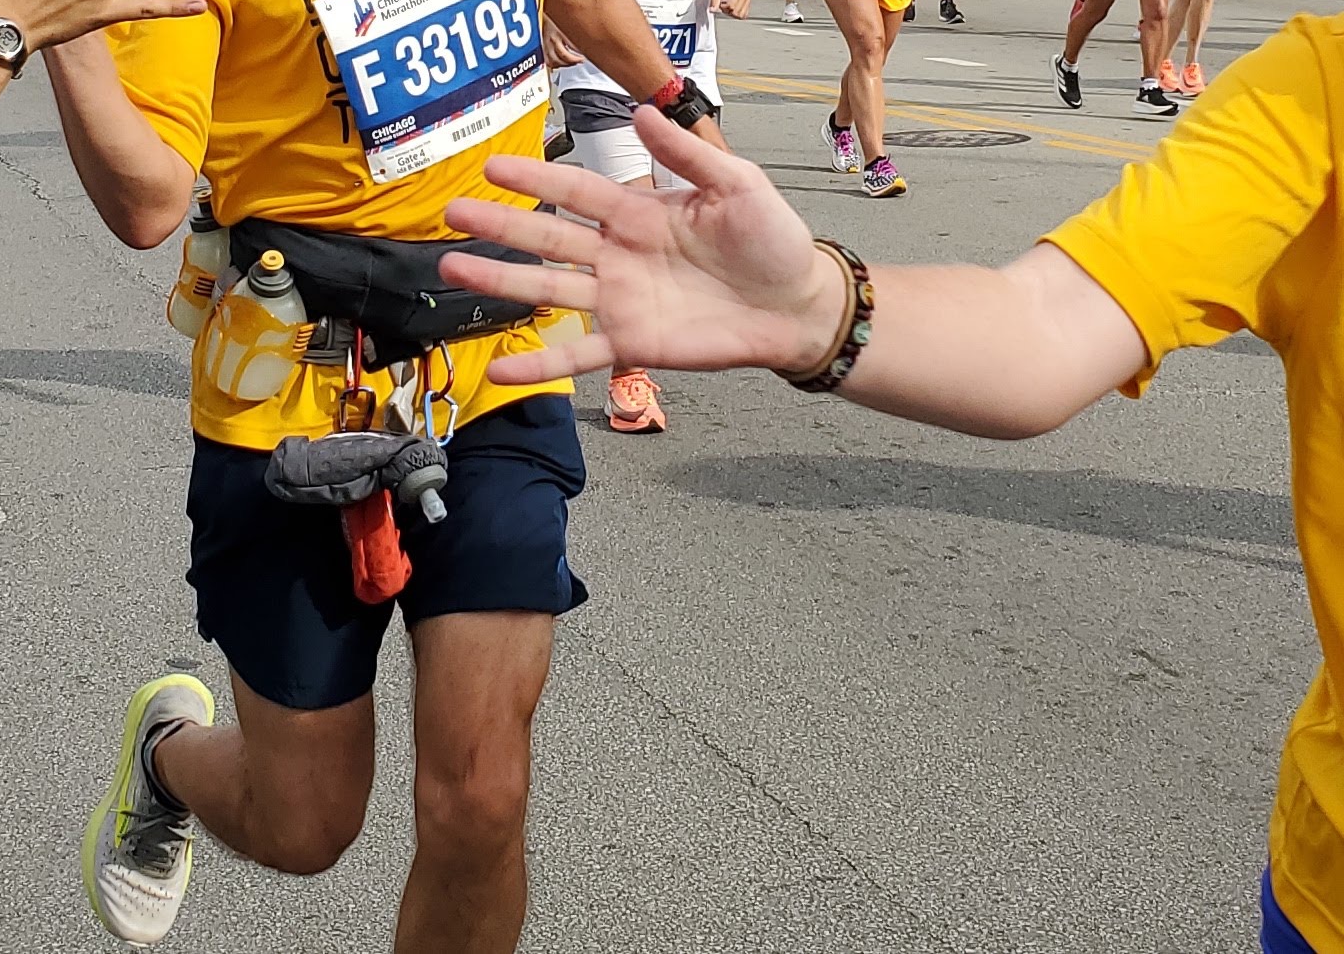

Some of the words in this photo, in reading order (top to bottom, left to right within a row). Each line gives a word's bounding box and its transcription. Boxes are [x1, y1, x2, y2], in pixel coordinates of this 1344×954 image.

[351, 49, 387, 116] F
[371, 115, 416, 140] CHICAGO
[397, 153, 419, 167] Gate
[419, 148, 426, 157] 4
